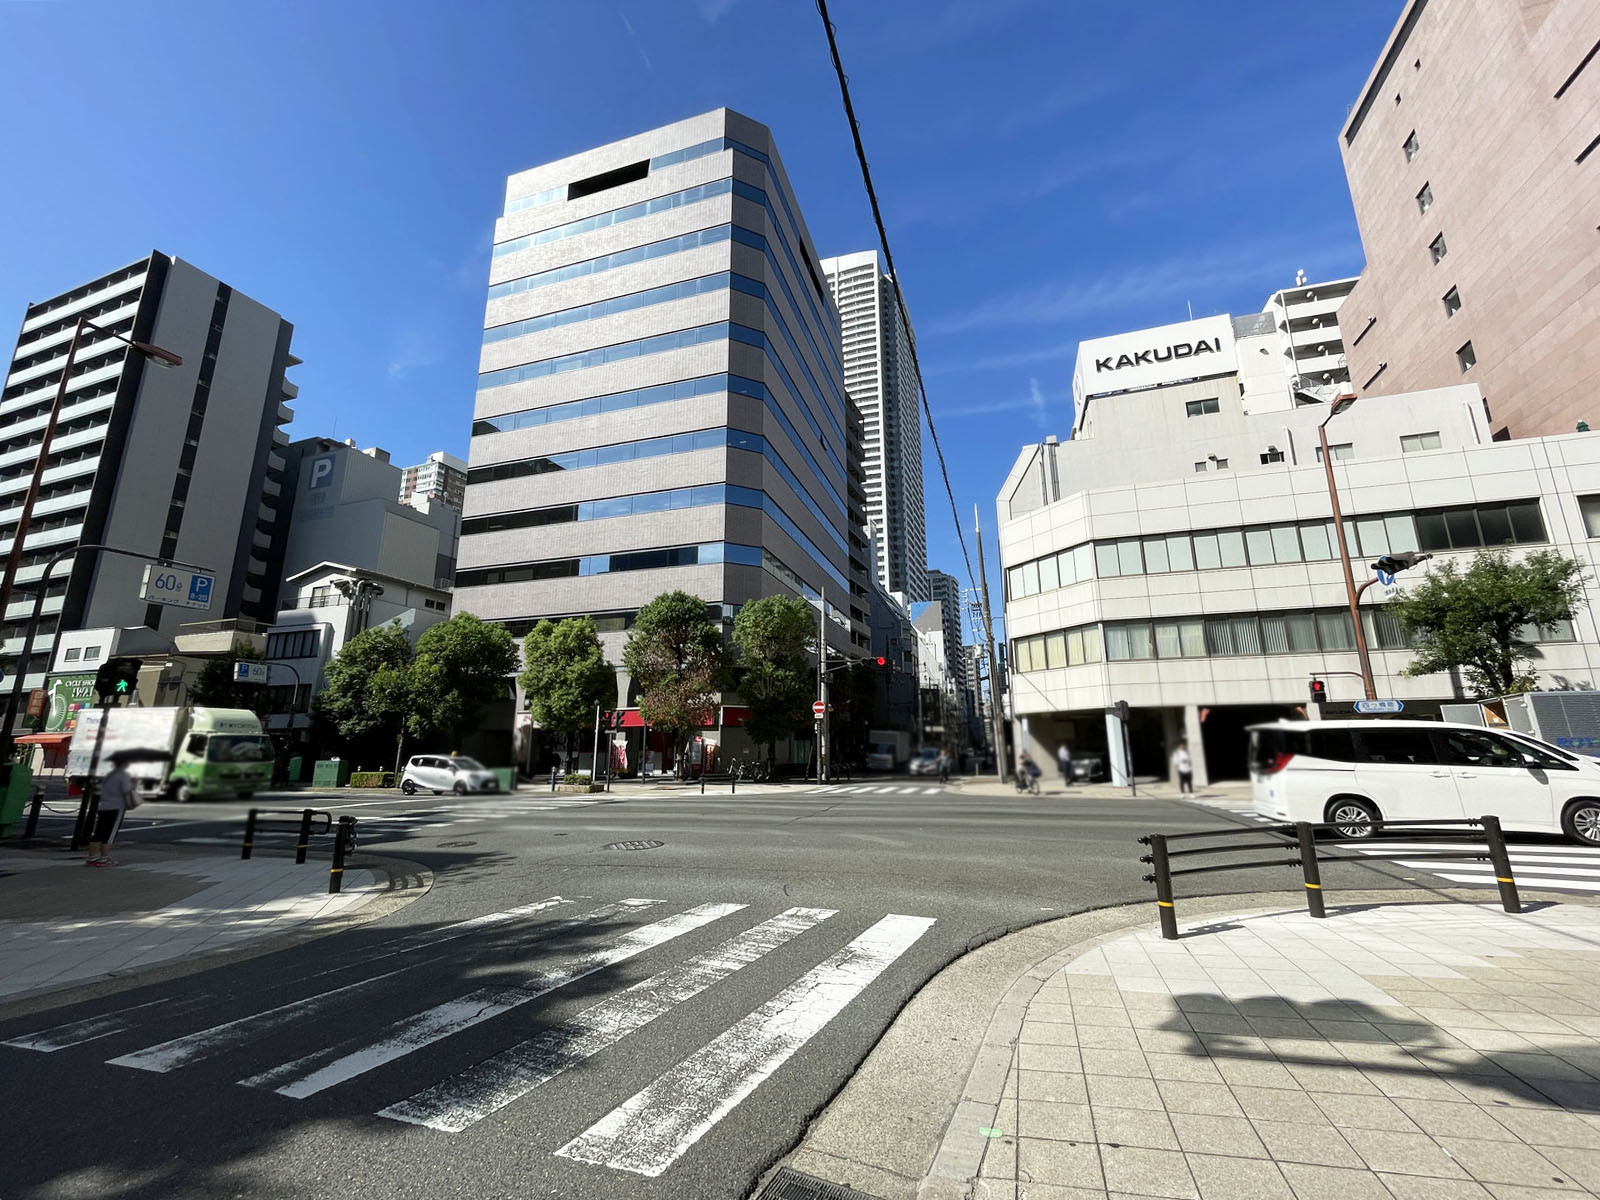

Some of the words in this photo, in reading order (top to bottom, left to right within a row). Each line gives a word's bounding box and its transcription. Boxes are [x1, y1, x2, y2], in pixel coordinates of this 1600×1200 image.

[1096, 338, 1222, 373] KAKUDAI
[311, 459, 332, 488] P
[196, 578, 208, 592] P
